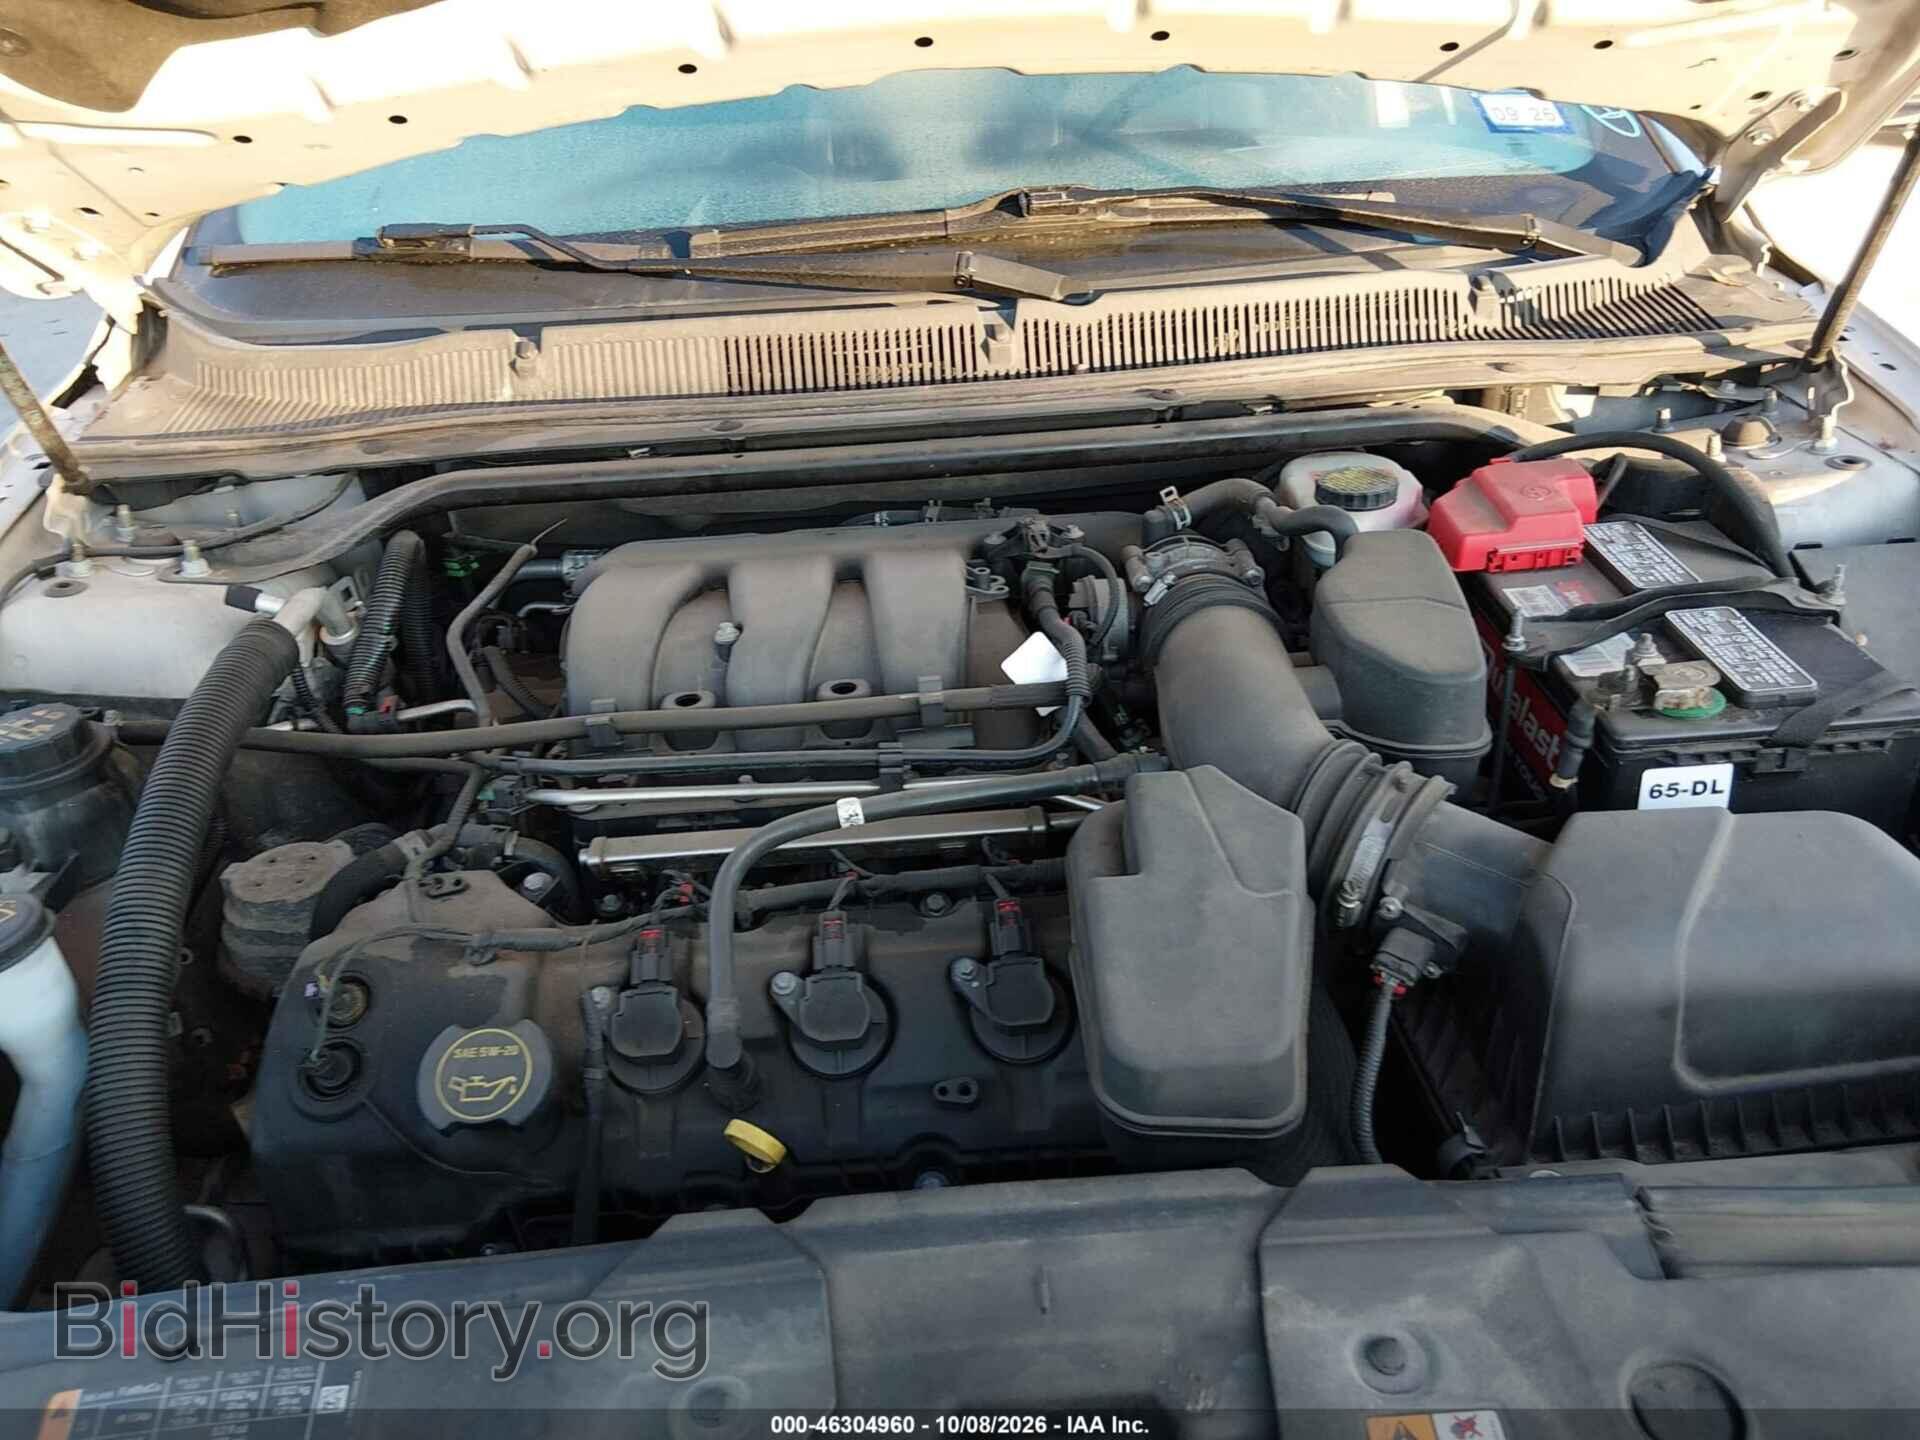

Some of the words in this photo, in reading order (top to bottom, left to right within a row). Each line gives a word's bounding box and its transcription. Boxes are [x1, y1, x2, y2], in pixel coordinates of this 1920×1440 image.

[1481, 636, 1560, 770] ualast
[1649, 779, 1725, 800] 65-DL
[453, 1047, 479, 1059] SAE
[479, 1045, 520, 1057] 5W-20
